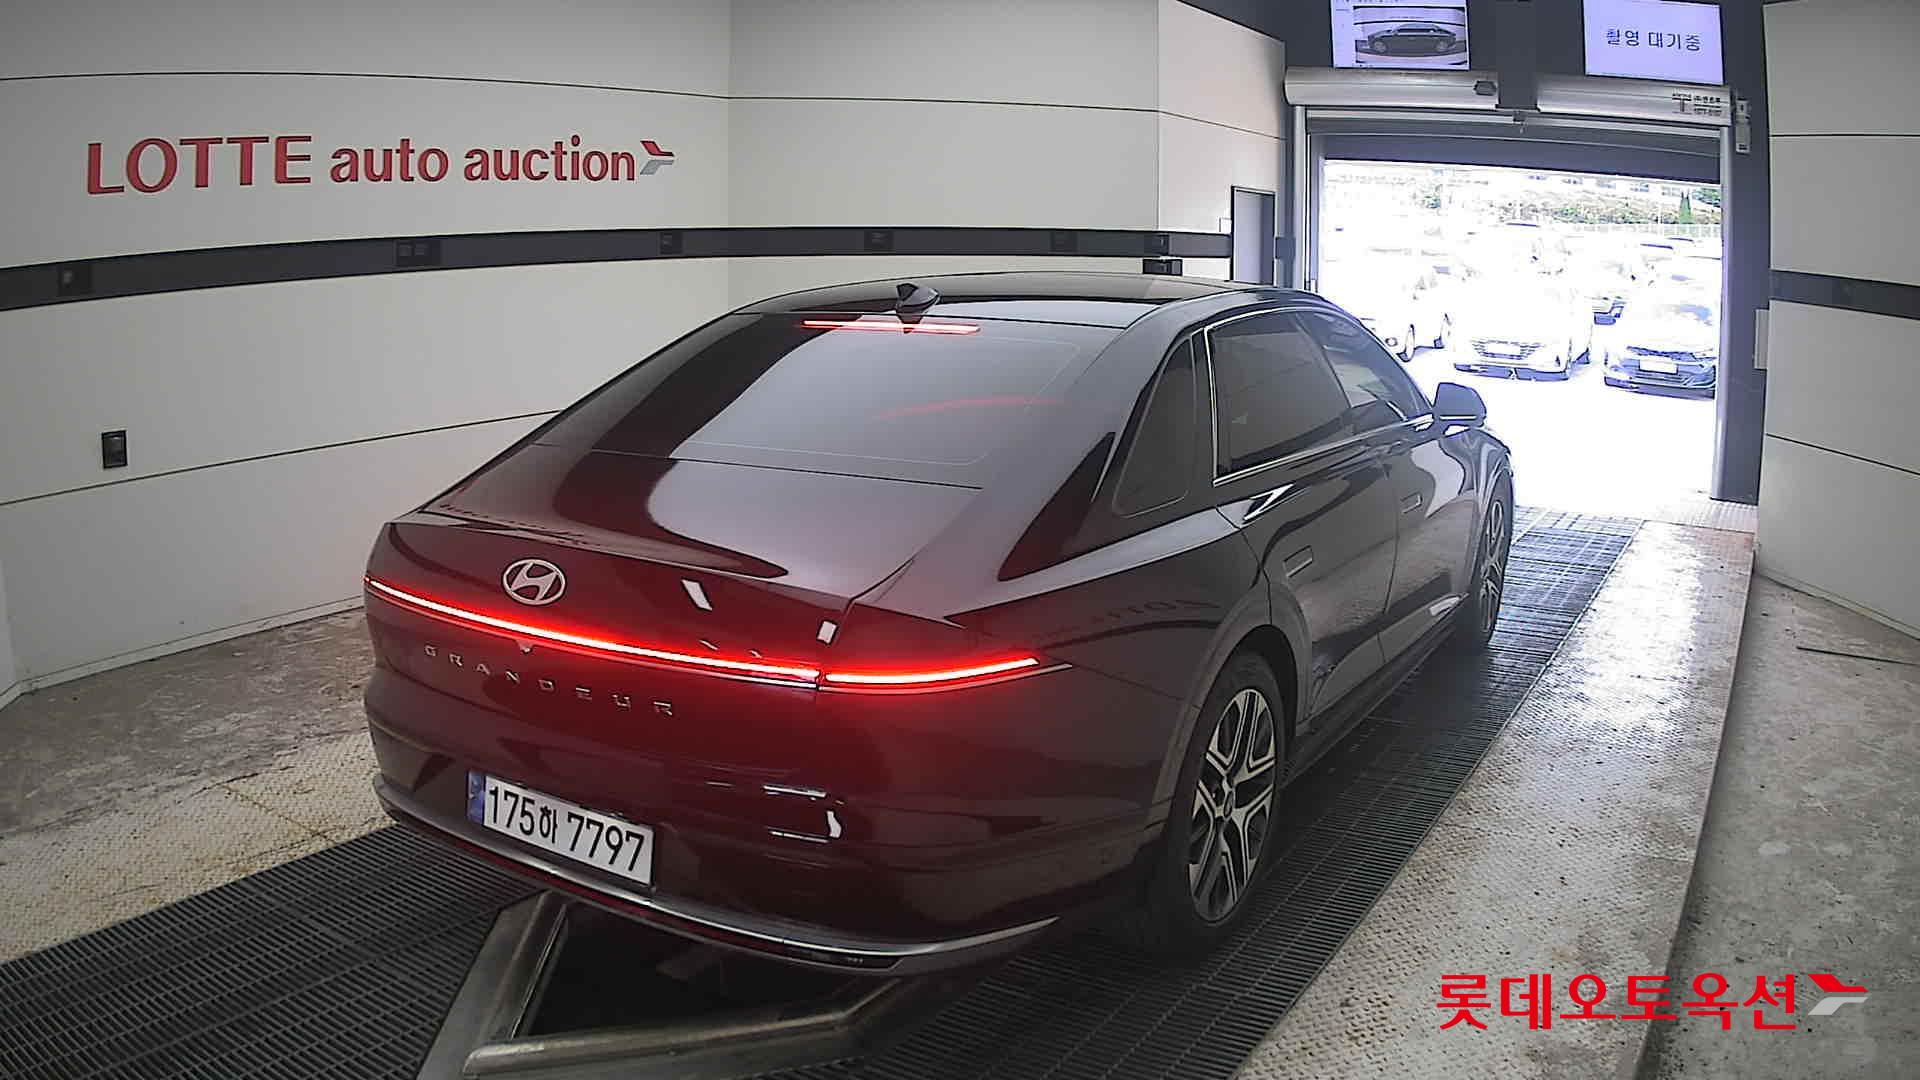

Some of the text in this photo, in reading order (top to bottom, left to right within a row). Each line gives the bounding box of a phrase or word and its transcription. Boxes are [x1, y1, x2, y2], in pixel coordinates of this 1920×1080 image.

[1606, 28, 1700, 52] 촬영 대기중
[87, 135, 635, 194] LOTTE auto auction
[425, 645, 673, 716] GRANDEUR
[489, 786, 645, 872] 175하 7797
